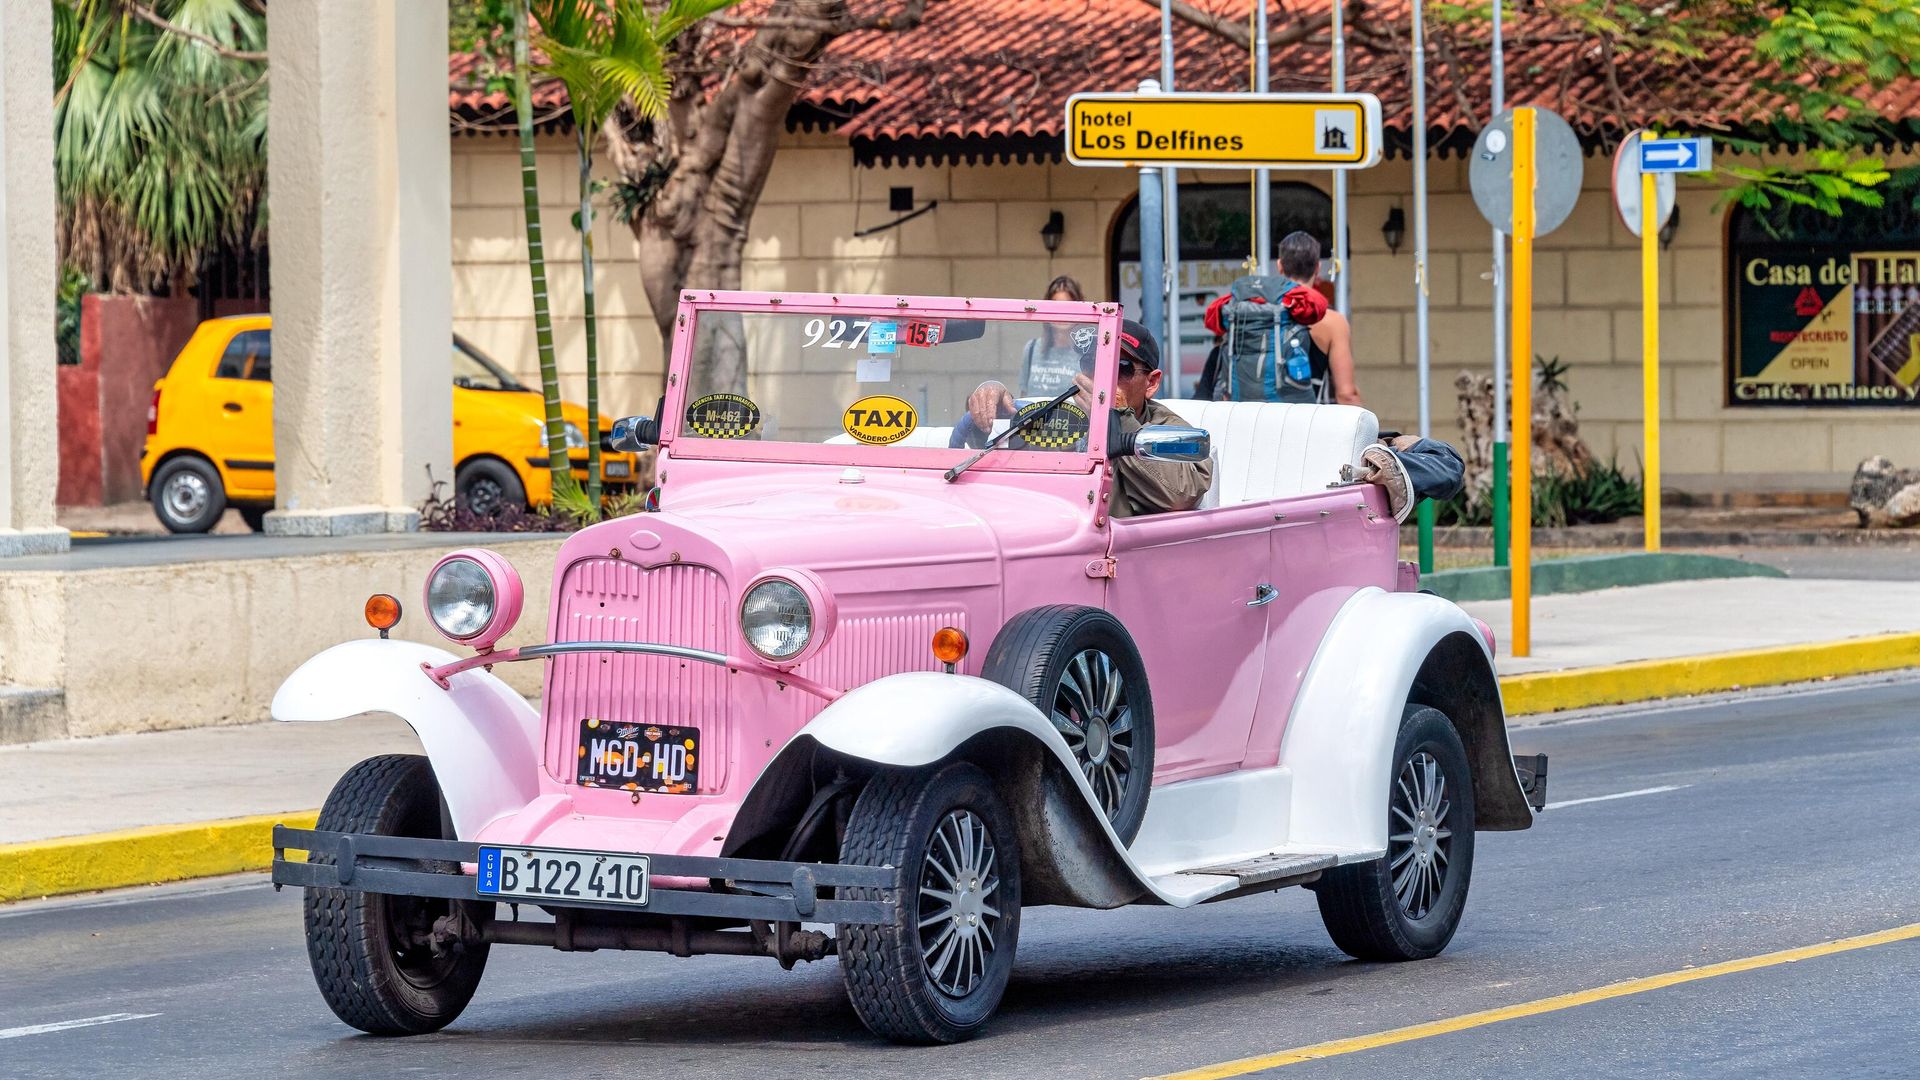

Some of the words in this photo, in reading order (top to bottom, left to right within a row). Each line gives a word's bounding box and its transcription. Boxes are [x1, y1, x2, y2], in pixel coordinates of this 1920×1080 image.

[1081, 111, 1132, 127] hotel
[1080, 130, 1126, 150] Los
[1136, 130, 1244, 151] Delfines
[1745, 258, 1812, 286] Casa
[1818, 258, 1859, 285] del
[802, 319, 873, 350] 927
[909, 322, 928, 345] 15
[1770, 330, 1848, 342] TECRISTO
[1791, 357, 1830, 369] OPEN
[1812, 383, 1898, 400] Tabaco
[706, 409, 741, 423] M-462
[849, 409, 913, 428] TAXI
[849, 425, 911, 442] VARADERO-CUBA
[589, 738, 639, 778] MGD
[652, 743, 687, 781] HD
[485, 854, 494, 887] CUBA
[501, 856, 519, 891] B
[526, 858, 581, 896] 122
[588, 862, 644, 900] 410
